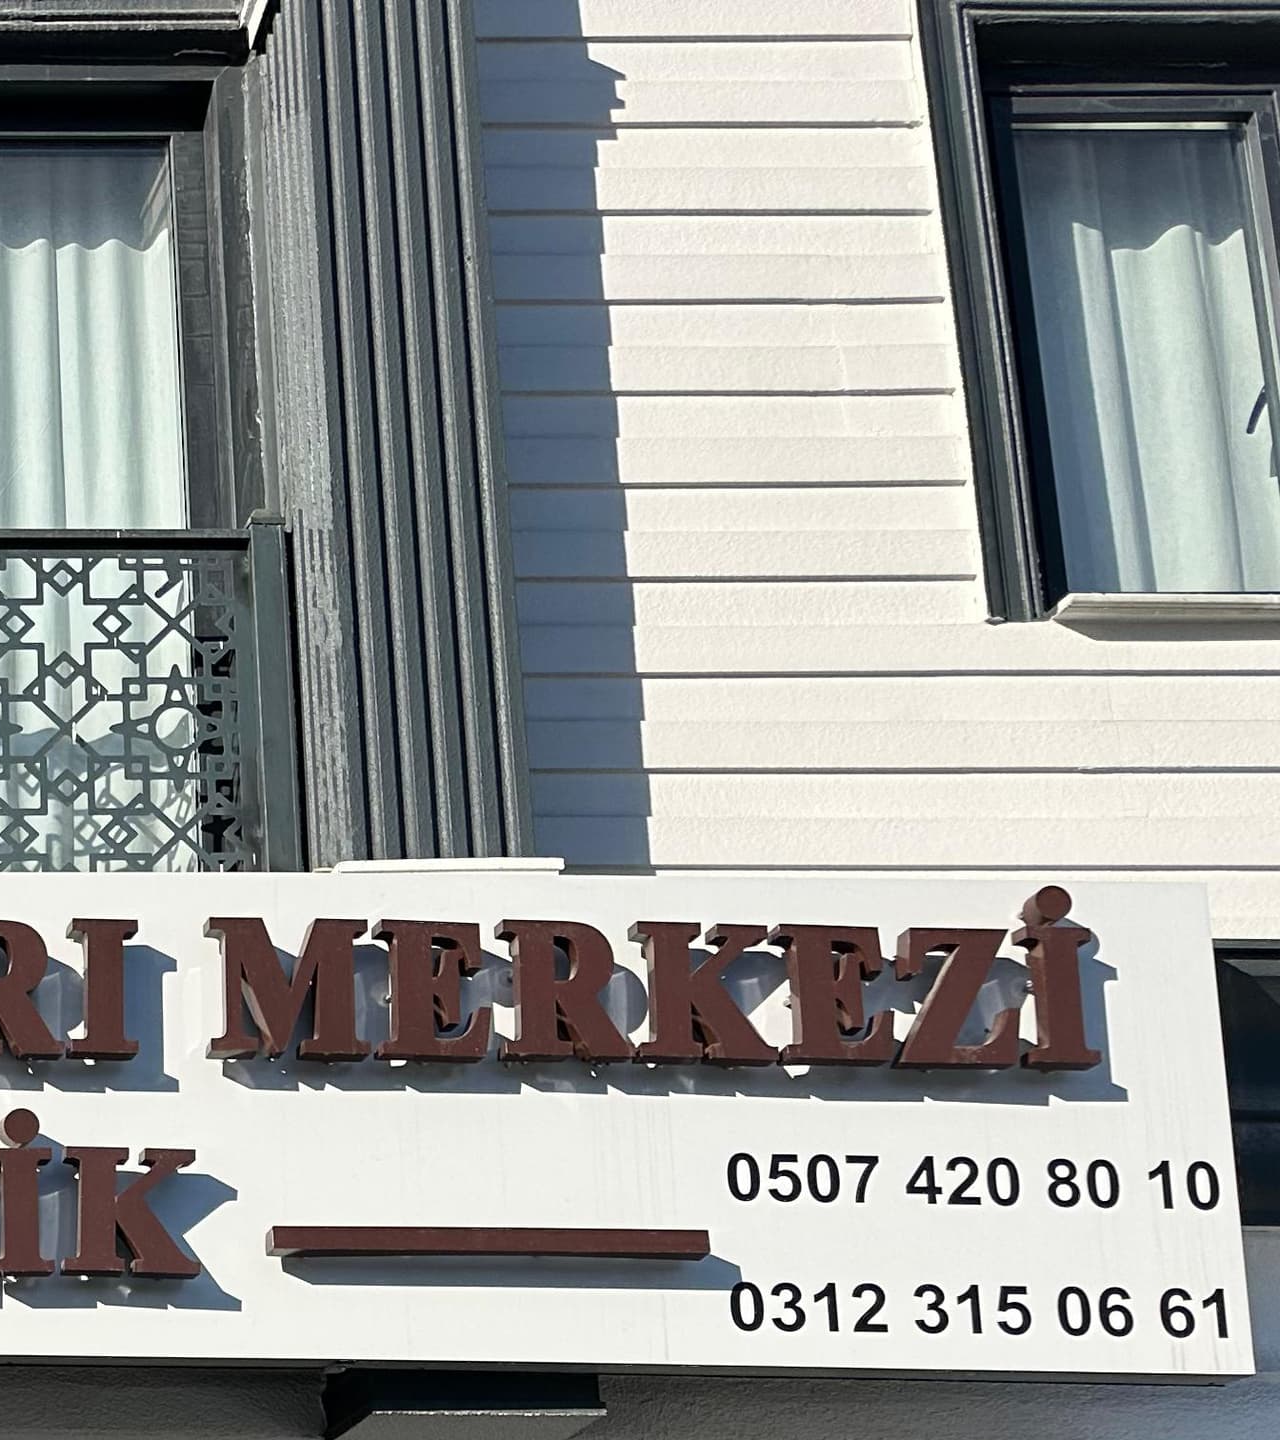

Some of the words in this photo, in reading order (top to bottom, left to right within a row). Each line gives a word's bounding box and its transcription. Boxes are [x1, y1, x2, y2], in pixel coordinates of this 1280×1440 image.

[203, 885, 1102, 1070] MERKEZİ
[726, 1152, 879, 1205] 0507
[905, 1155, 1021, 1208] 420
[1046, 1157, 1121, 1210] 80
[1147, 1159, 1221, 1212] 10
[730, 1281, 888, 1333] 0312
[912, 1283, 1032, 1336] 315
[1056, 1286, 1134, 1338] 06
[1158, 1287, 1230, 1340] 61
